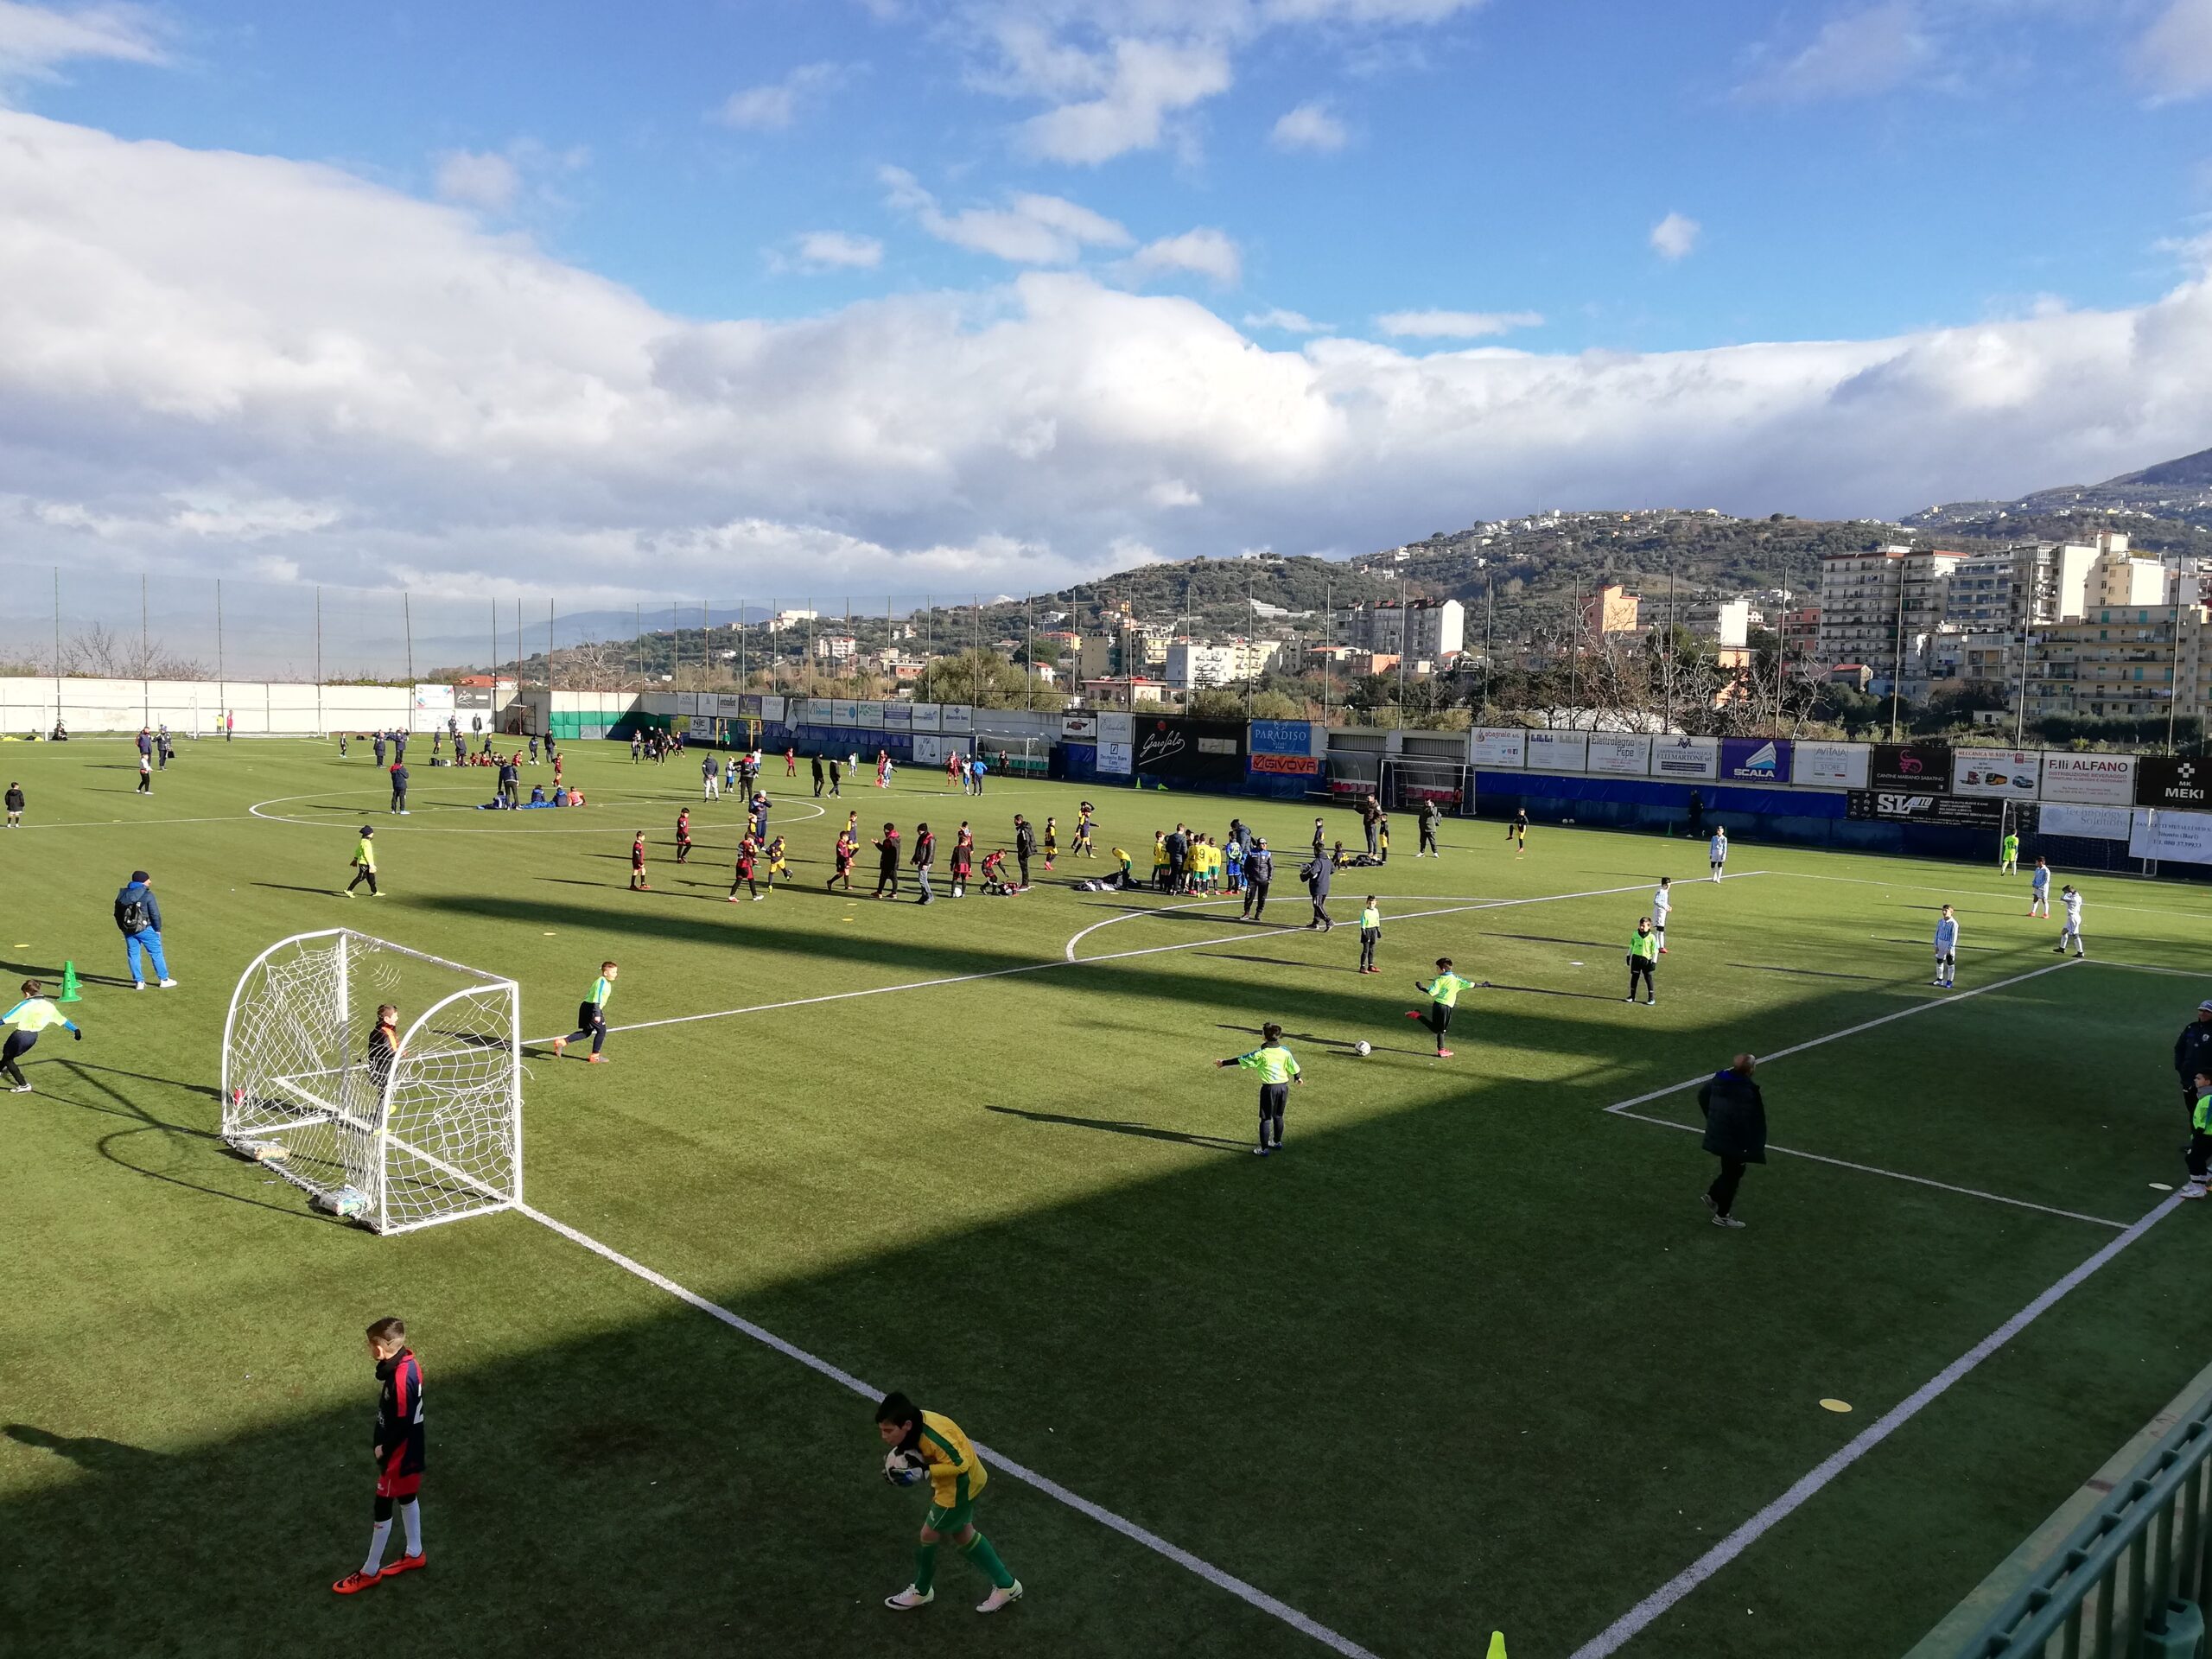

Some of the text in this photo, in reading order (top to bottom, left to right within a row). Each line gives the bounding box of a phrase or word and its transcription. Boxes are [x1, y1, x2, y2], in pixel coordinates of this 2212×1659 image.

[1255, 728, 1306, 742] PARADISO
[1591, 734, 1635, 748] Elettrolegno
[1140, 730, 1185, 758] Garofalo
[1617, 746, 1635, 759] Pepe
[1264, 759, 1316, 772] GIVOVA
[2072, 760, 2128, 772] ALFANO
[1733, 768, 1775, 778] SCALA
[2164, 787, 2204, 799] MEKI
[2066, 807, 2123, 819] Technology
[2081, 816, 2130, 827] Solutions
